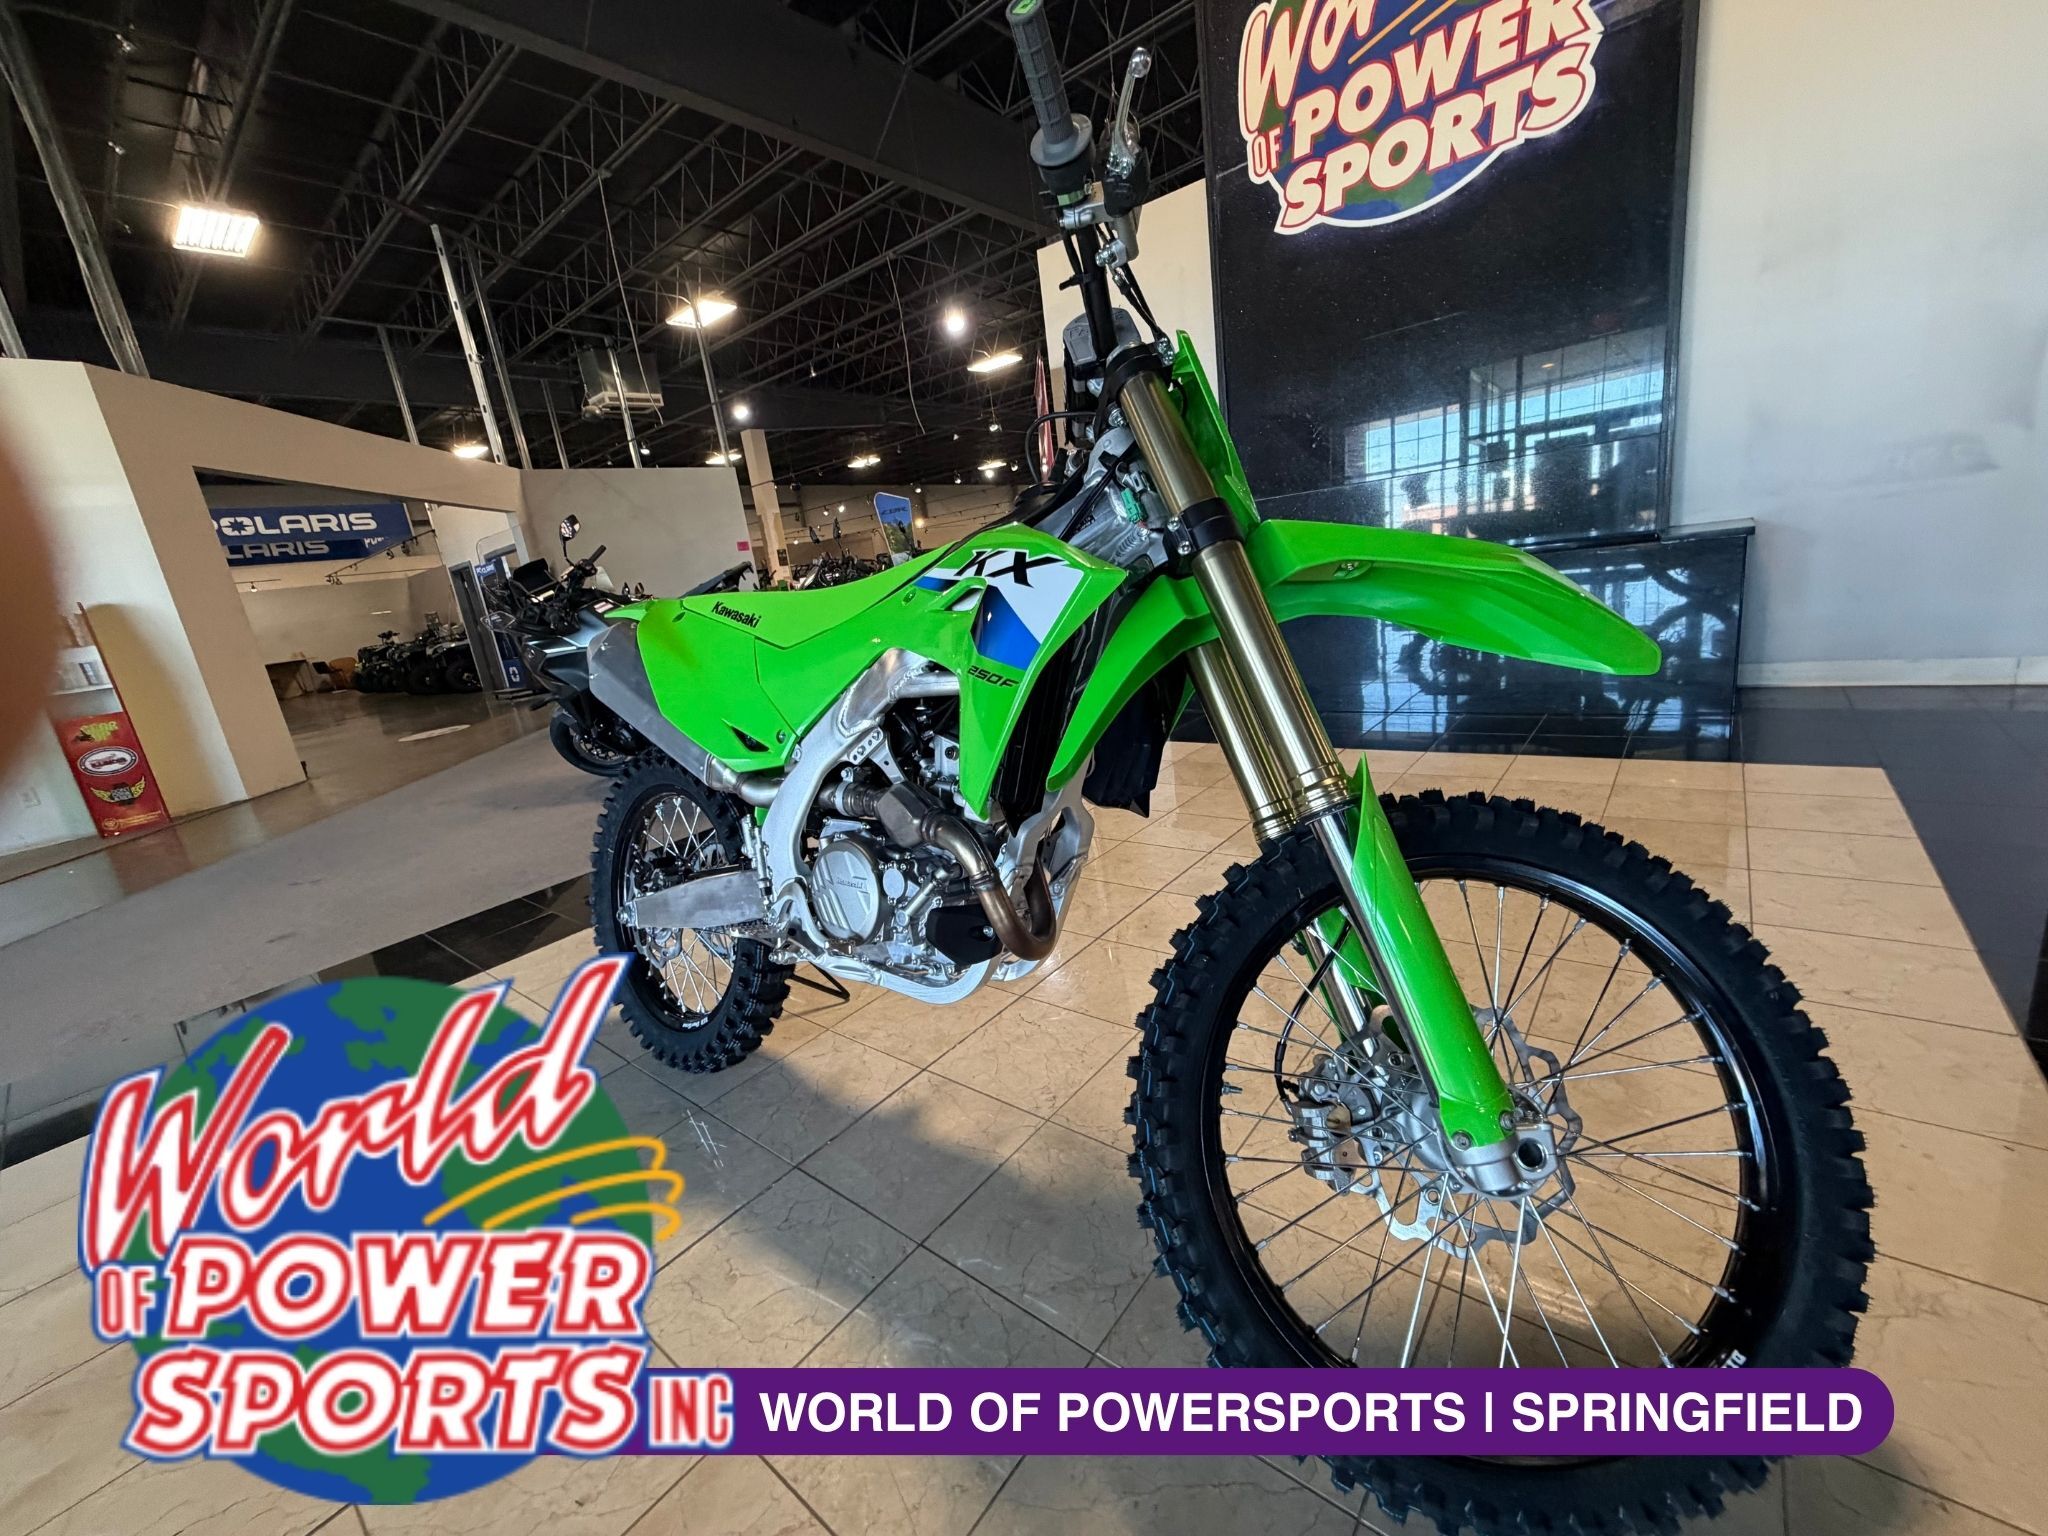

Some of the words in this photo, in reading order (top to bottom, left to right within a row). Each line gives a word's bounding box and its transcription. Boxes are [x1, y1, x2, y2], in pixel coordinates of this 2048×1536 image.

[1243, 0, 1378, 134] Wor
[1252, 124, 1284, 178] OF
[1288, 0, 1594, 162] POWER
[1280, 42, 1591, 229] SPORTS
[212, 512, 378, 537] OLARIS
[225, 539, 331, 560] LARIS
[953, 550, 1066, 588] KX
[711, 600, 762, 629] Kawasaki
[967, 665, 1020, 688] 250F
